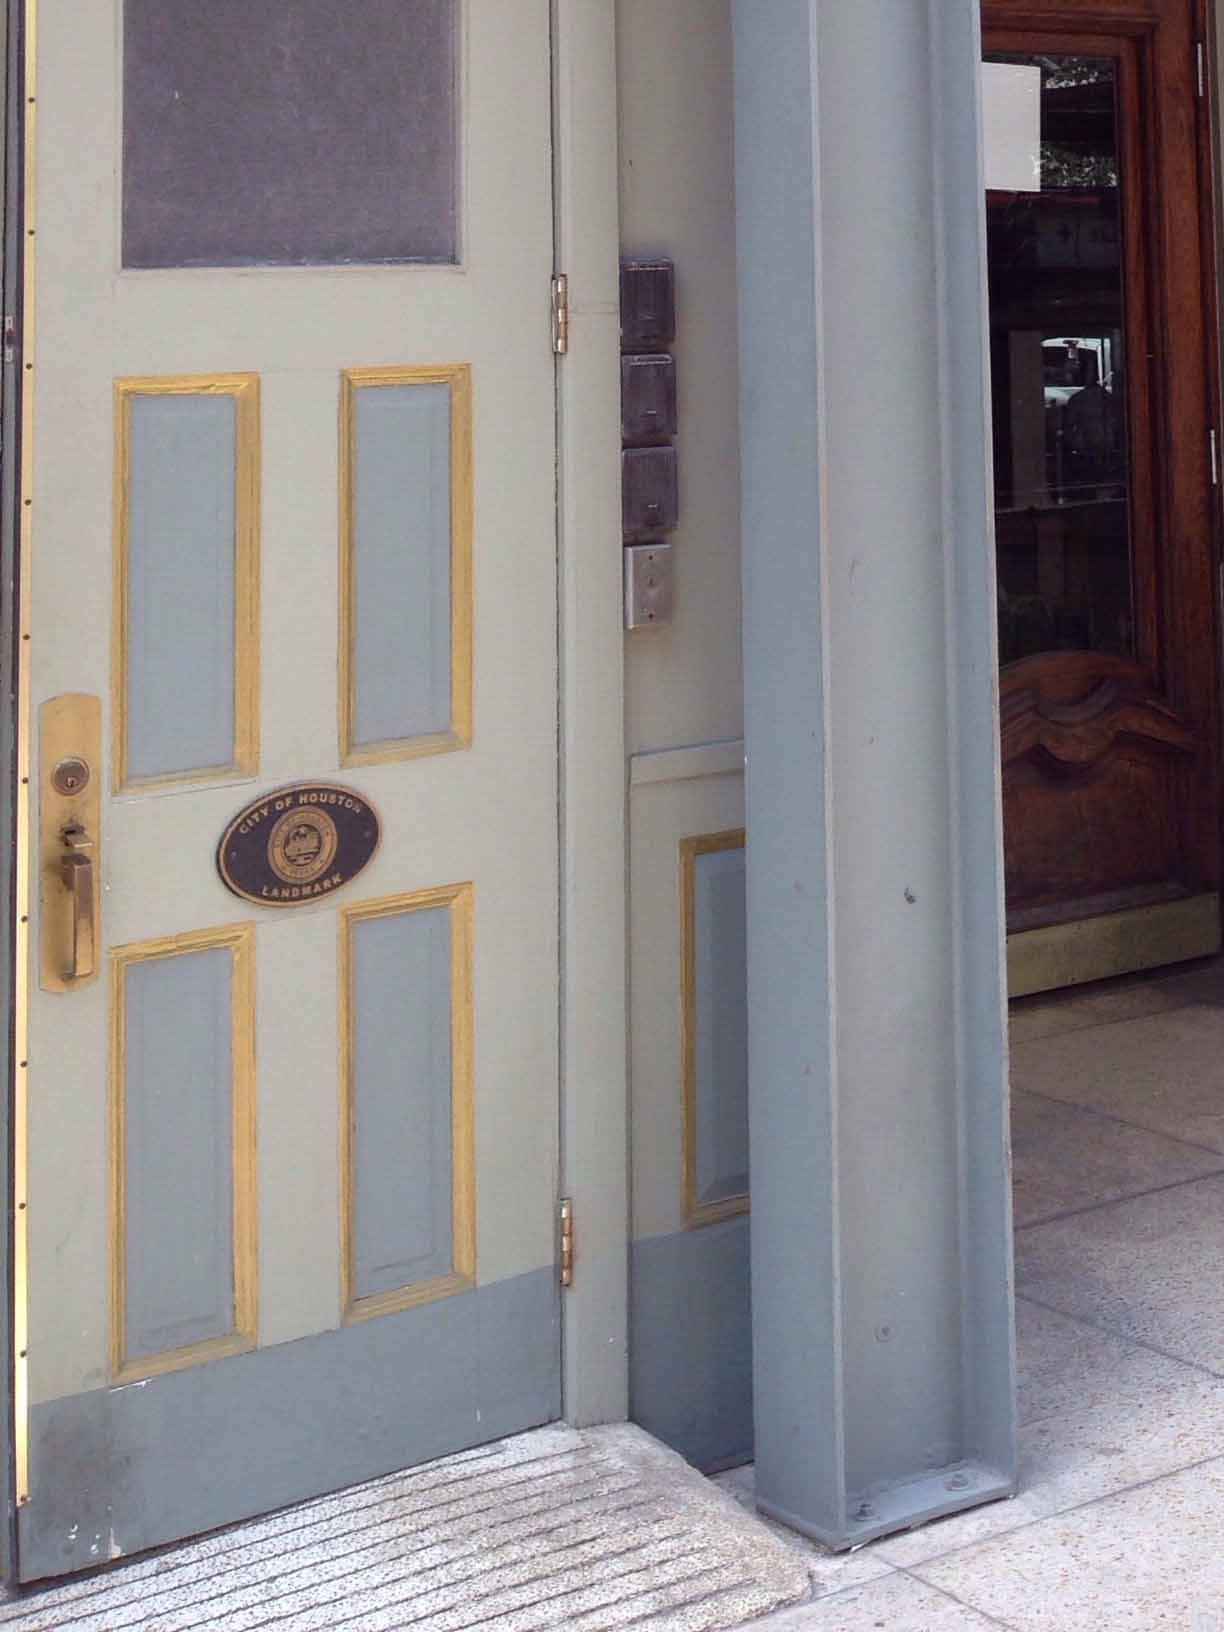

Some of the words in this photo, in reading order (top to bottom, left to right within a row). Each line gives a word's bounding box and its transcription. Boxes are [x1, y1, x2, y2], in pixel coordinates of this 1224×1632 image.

[239, 808, 269, 835] CITY
[275, 797, 294, 811] OF
[299, 792, 361, 816] HOUSTON
[261, 872, 343, 898] LANDMARK
